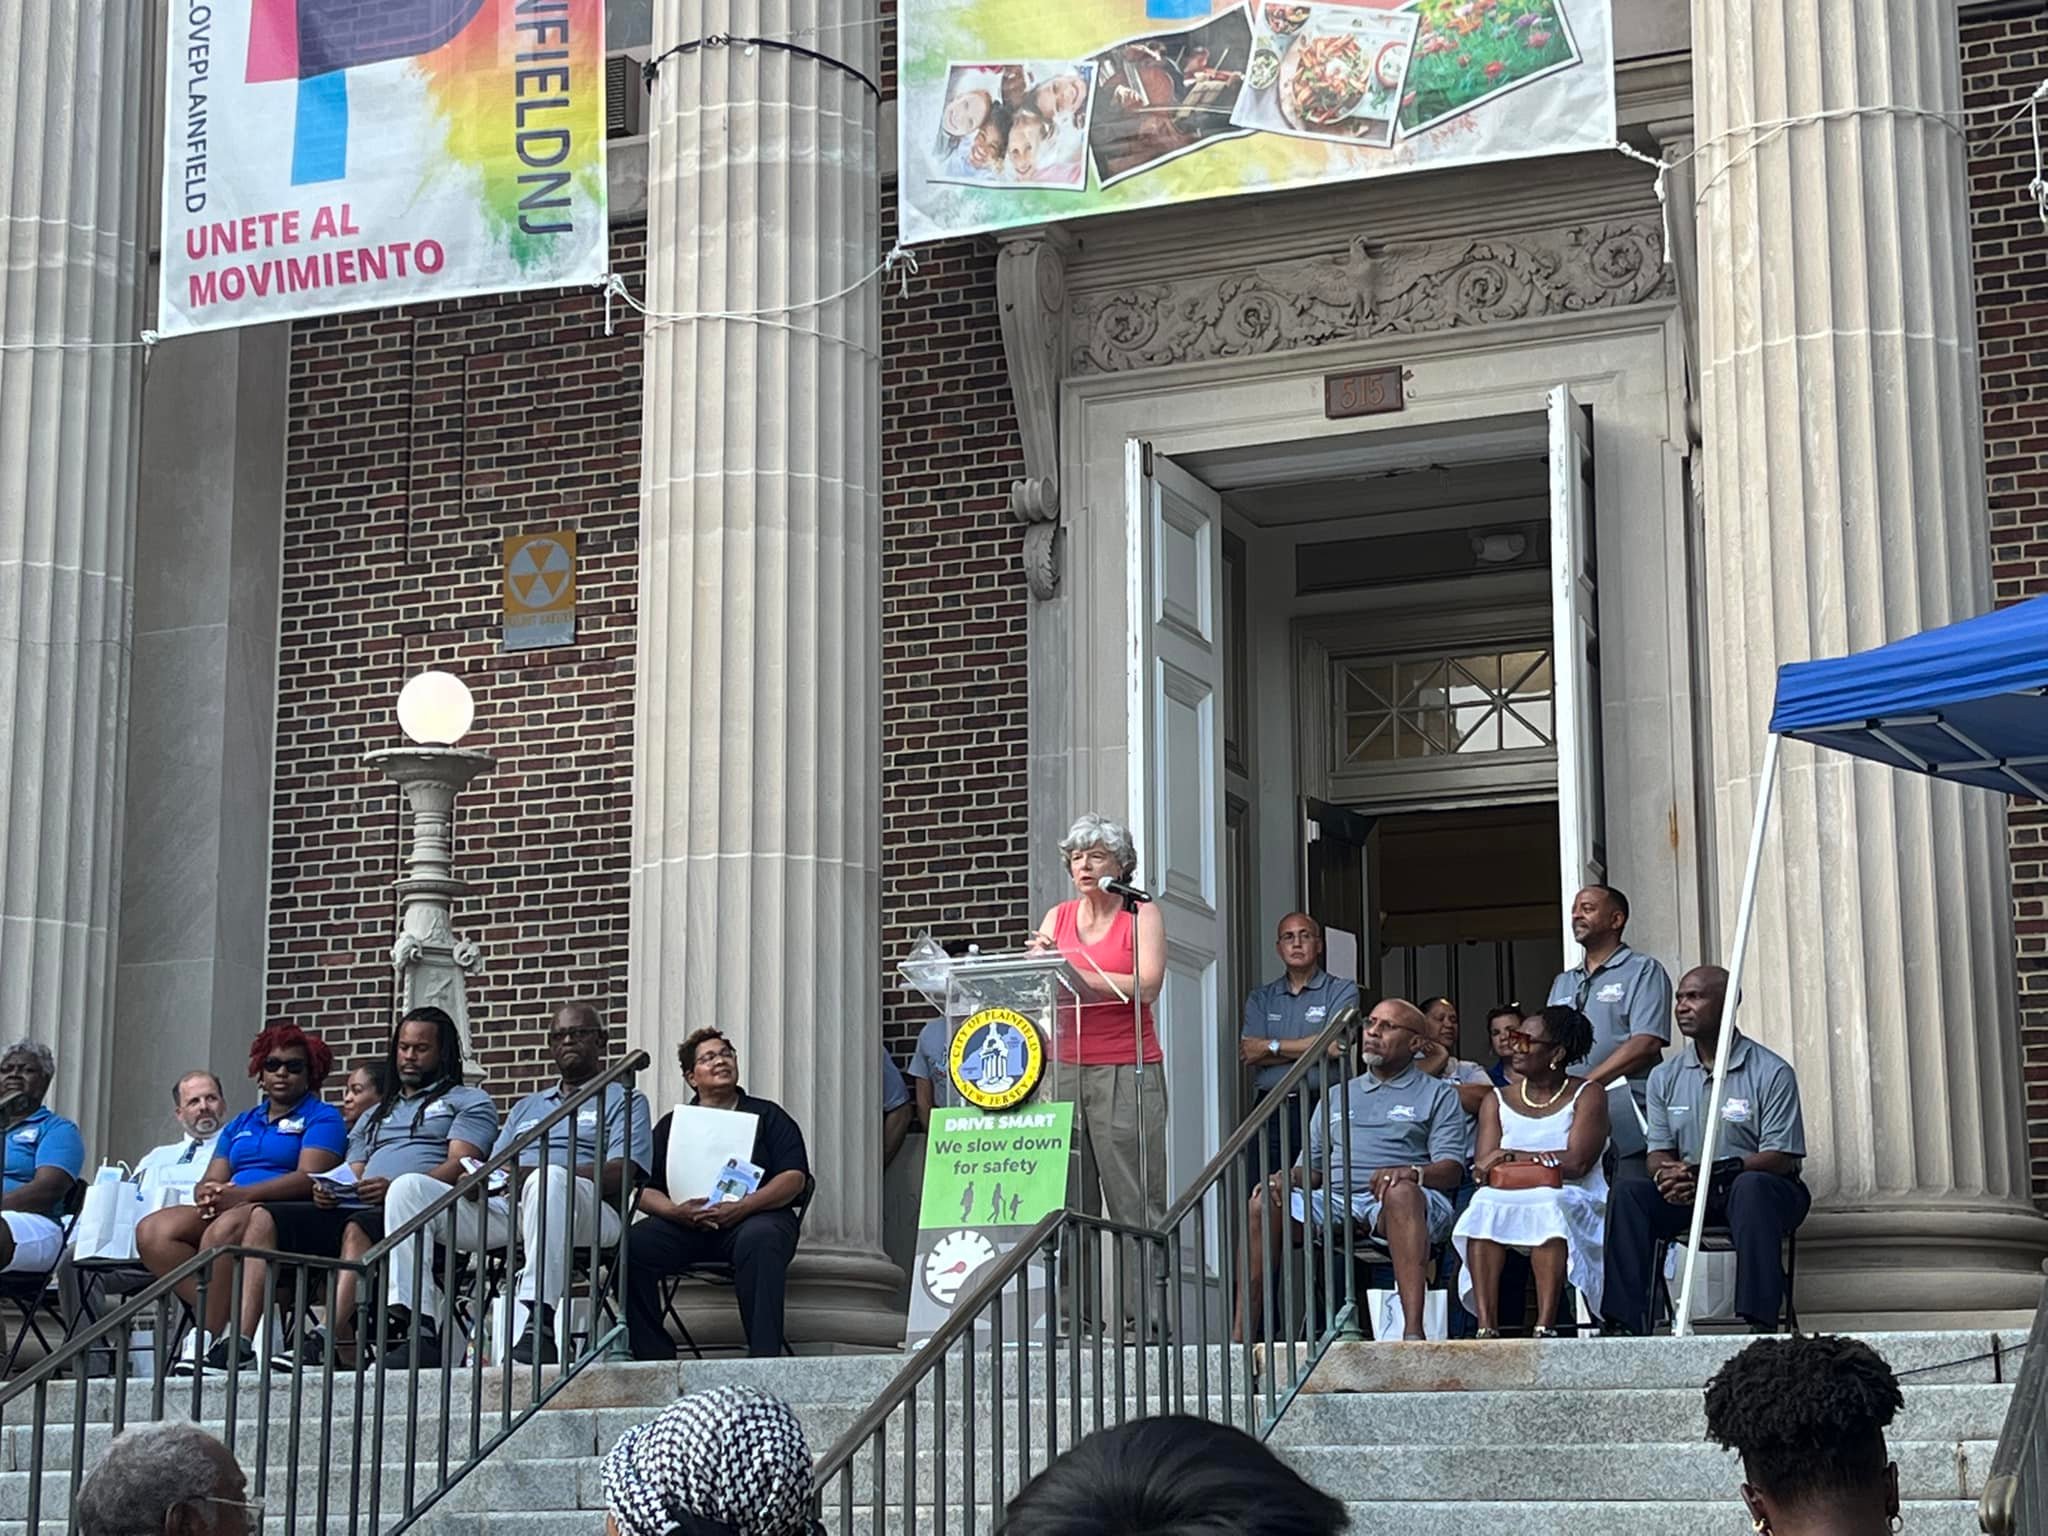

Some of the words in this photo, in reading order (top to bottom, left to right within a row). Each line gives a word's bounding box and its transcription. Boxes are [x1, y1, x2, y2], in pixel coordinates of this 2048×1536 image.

[186, 210, 300, 260] UNETE
[311, 204, 360, 240] AL
[188, 239, 446, 308] MOVIMIENTO
[1341, 375, 1385, 409] 515
[952, 1030, 968, 1058] CITY
[967, 1014, 981, 1029] OF
[984, 1010, 1039, 1052] PLAINFIELD
[961, 1083, 985, 1103] NEW
[989, 1081, 1029, 1106] JERSEY
[944, 1116, 996, 1132] DRIVE
[998, 1113, 1056, 1129] SMART
[935, 1140, 962, 1154] We
[967, 1138, 1008, 1153] slow
[1012, 1136, 1062, 1151] down
[953, 1160, 979, 1175] for
[983, 1158, 1038, 1175] safety
